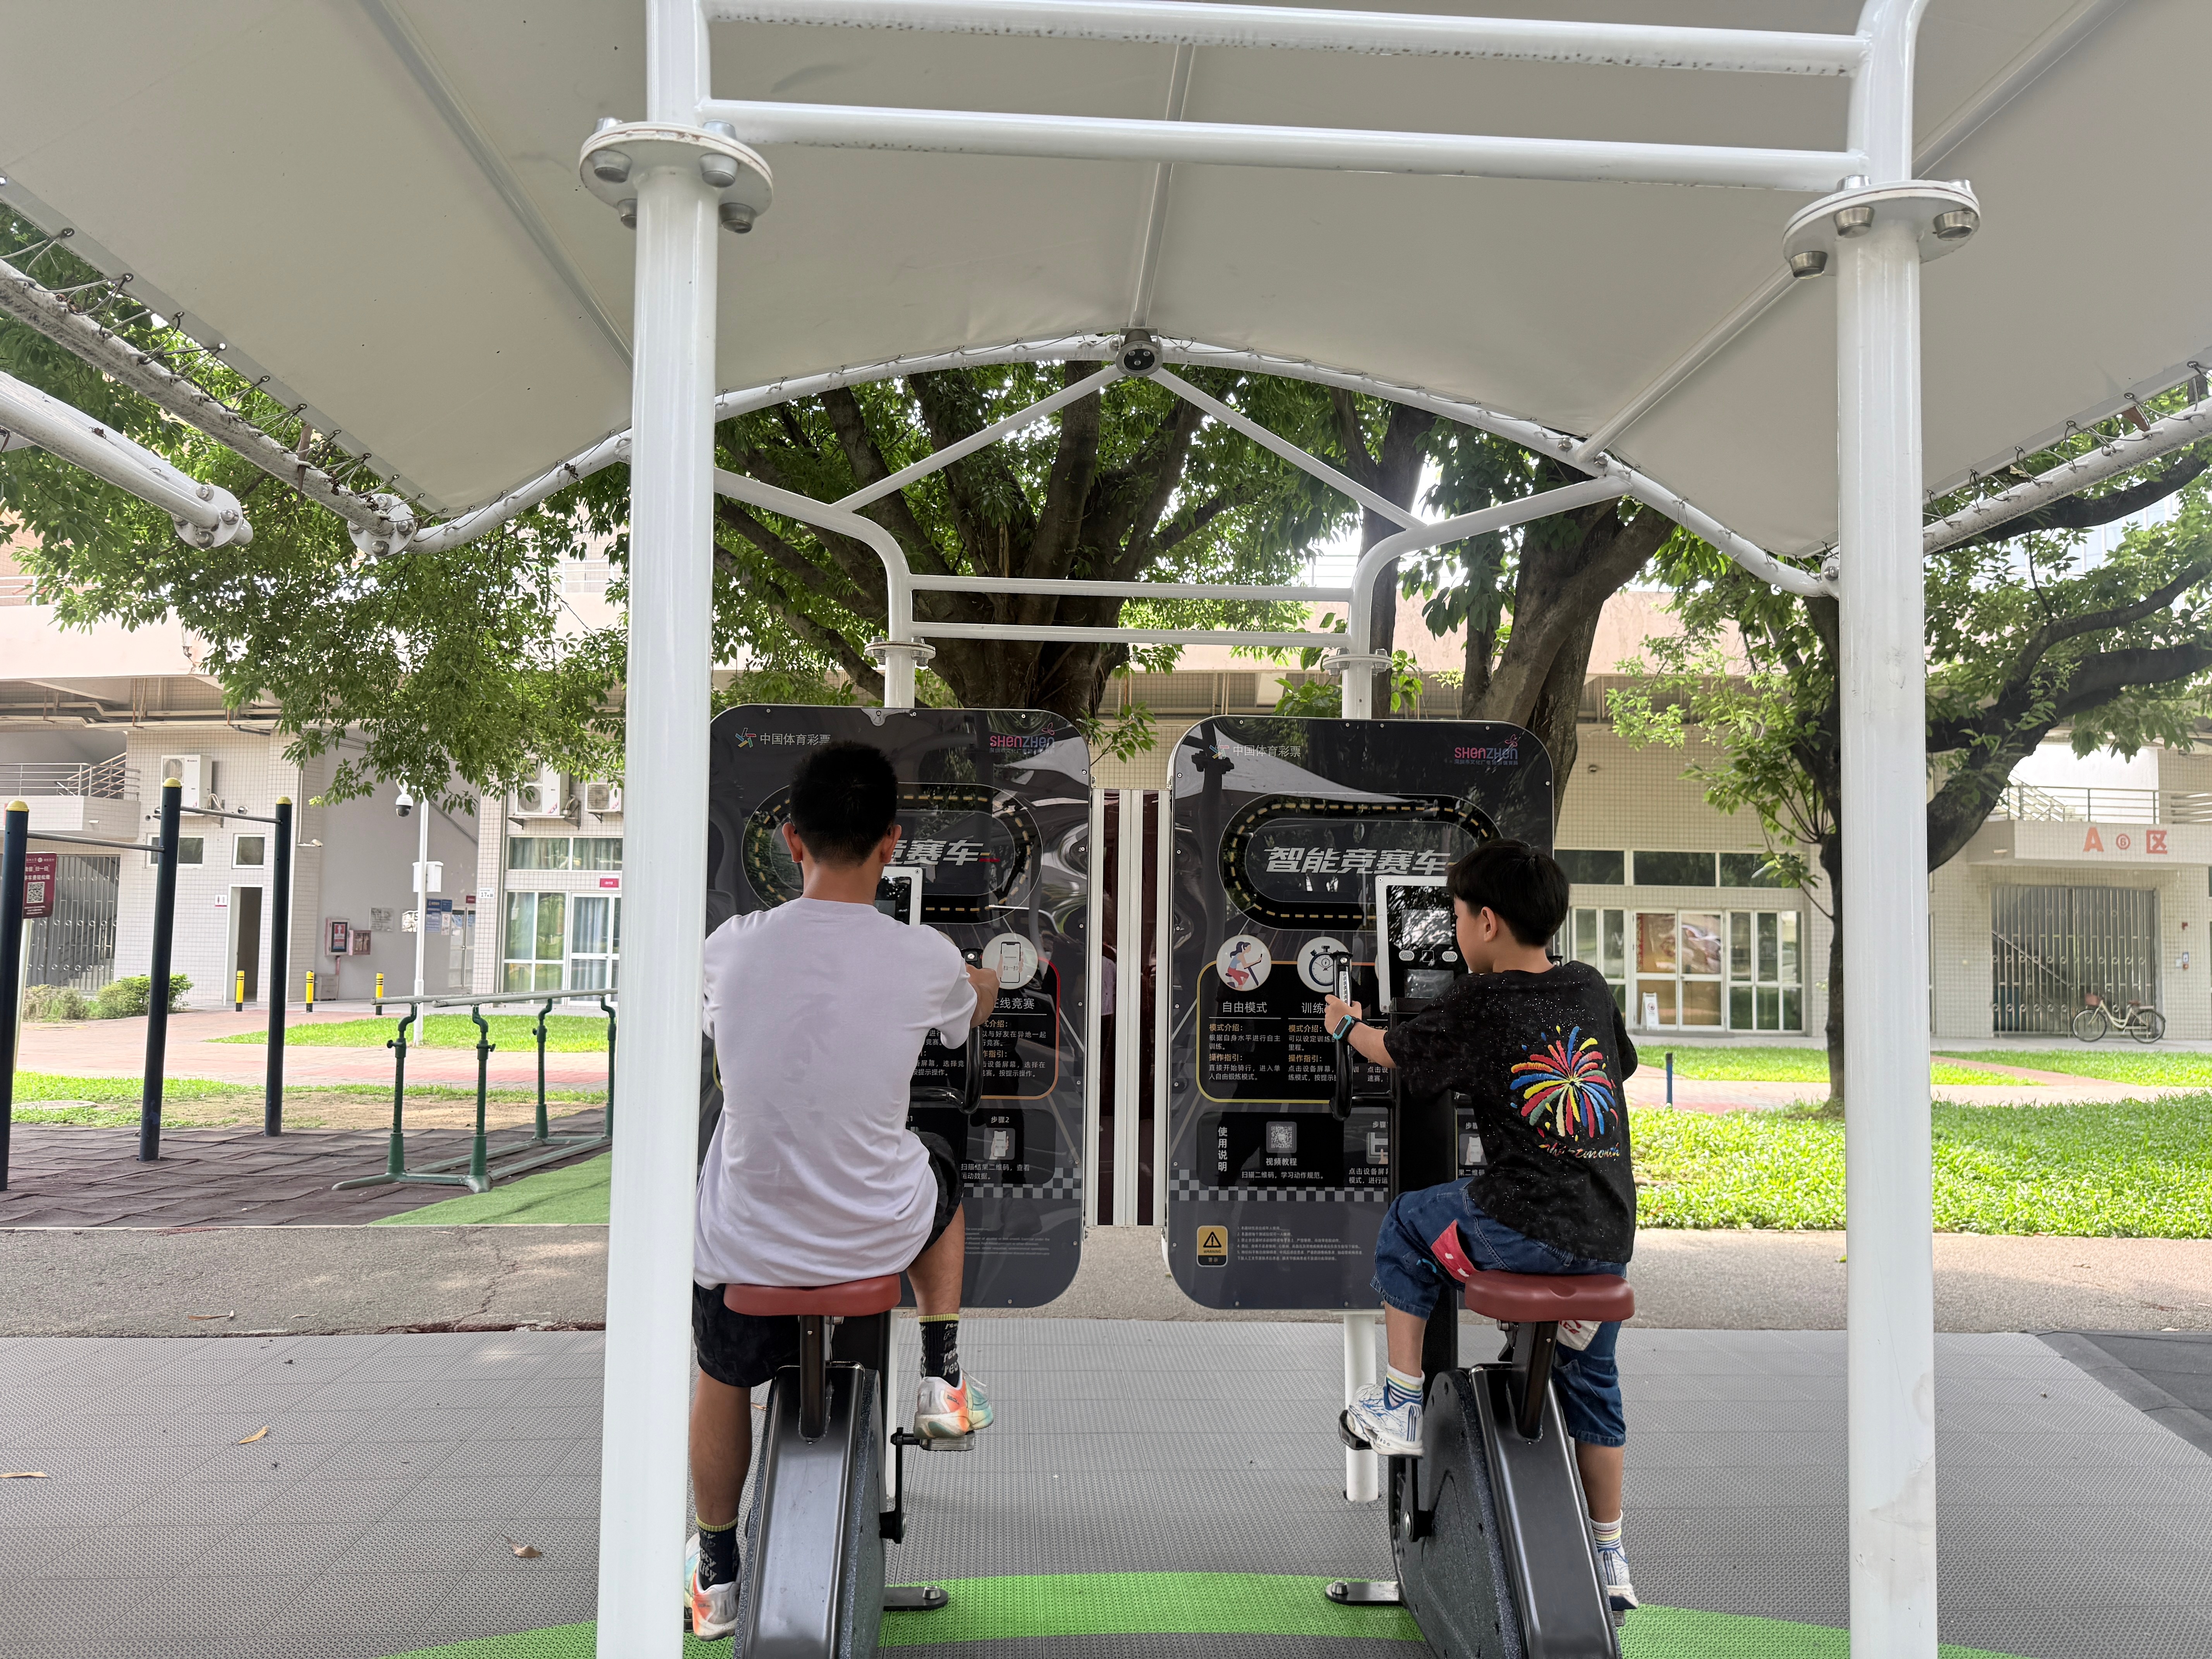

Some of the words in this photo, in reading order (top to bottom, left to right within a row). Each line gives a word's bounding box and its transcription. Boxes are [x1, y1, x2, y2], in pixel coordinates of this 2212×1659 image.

[760, 733, 831, 745] 中国体育彩票
[1233, 745, 1301, 757] 中国体育彩票
[2083, 827, 2104, 852] A
[2146, 830, 2167, 854] 区
[1264, 847, 1451, 875] 智能竞赛车
[1223, 1001, 1267, 1013] 自由模式
[1301, 1002, 1330, 1013] 训练
[1209, 1053, 1242, 1061] 操作指引：
[1218, 1127, 1228, 1171] 使用说明
[1266, 1158, 1297, 1166] 视频教程
[1242, 1171, 1323, 1179] 扫描二维码，学习动作规范。
